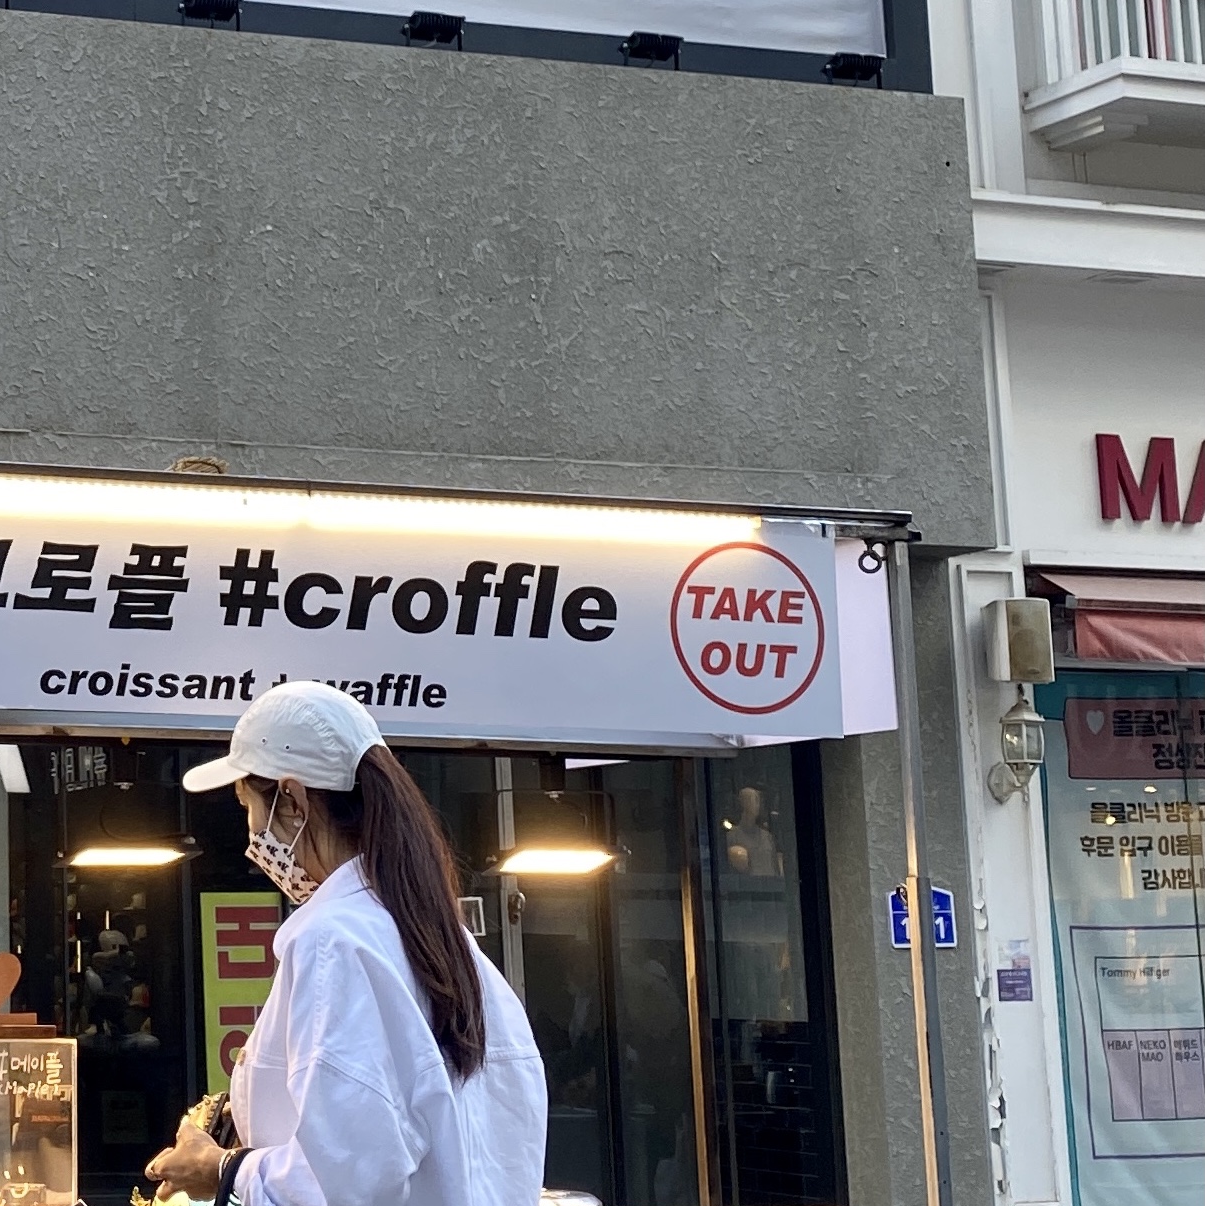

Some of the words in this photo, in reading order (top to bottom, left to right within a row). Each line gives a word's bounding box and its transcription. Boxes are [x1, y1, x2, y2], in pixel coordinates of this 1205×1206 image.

[219, 547, 618, 642] #croffle
[687, 585, 806, 625] TAKE
[700, 641, 798, 678] OUT
[40, 663, 255, 702] croissant
[1100, 967, 1136, 979] Tommy
[1140, 1040, 1166, 1050] NEKO
